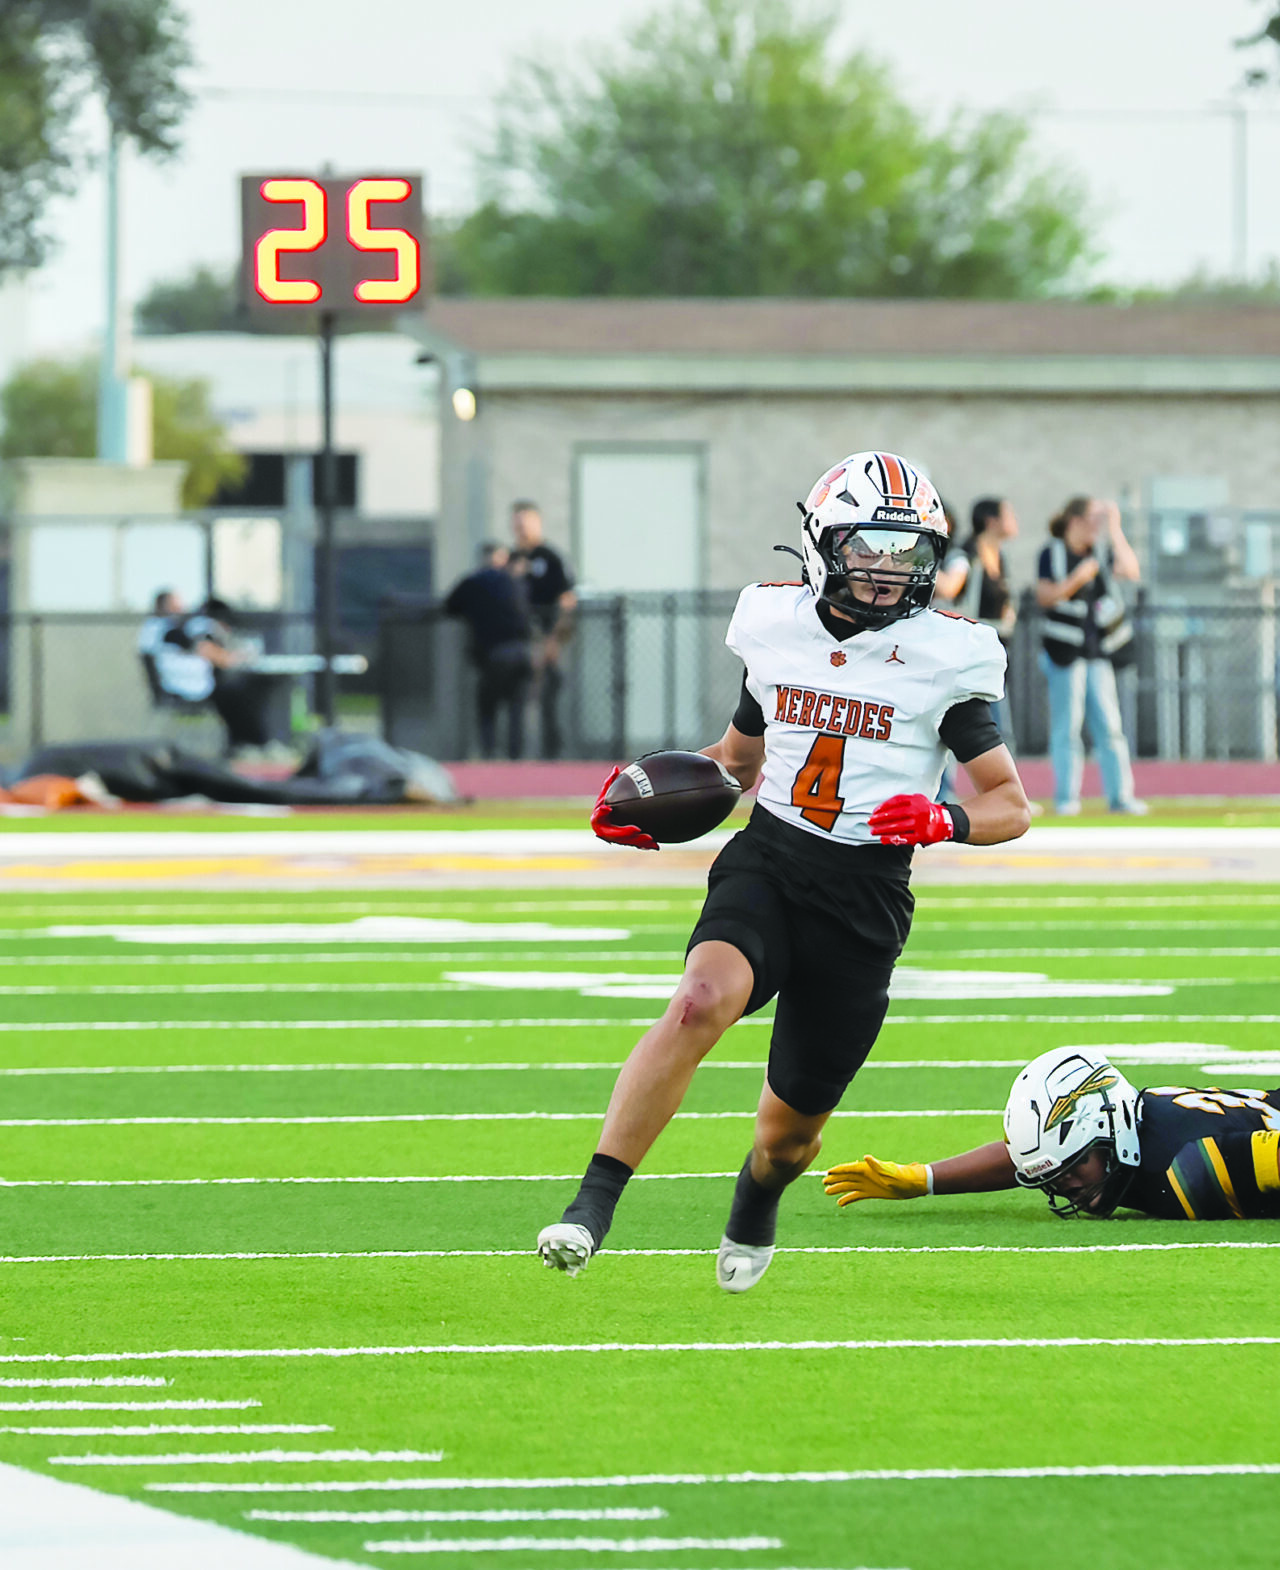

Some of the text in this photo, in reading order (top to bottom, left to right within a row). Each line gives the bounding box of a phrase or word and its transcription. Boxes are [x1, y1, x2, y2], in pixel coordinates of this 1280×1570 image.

[254, 177, 420, 304] 25
[876, 510, 918, 523] Riddell
[774, 685, 895, 742] MERCEDES
[791, 732, 847, 833] 4
